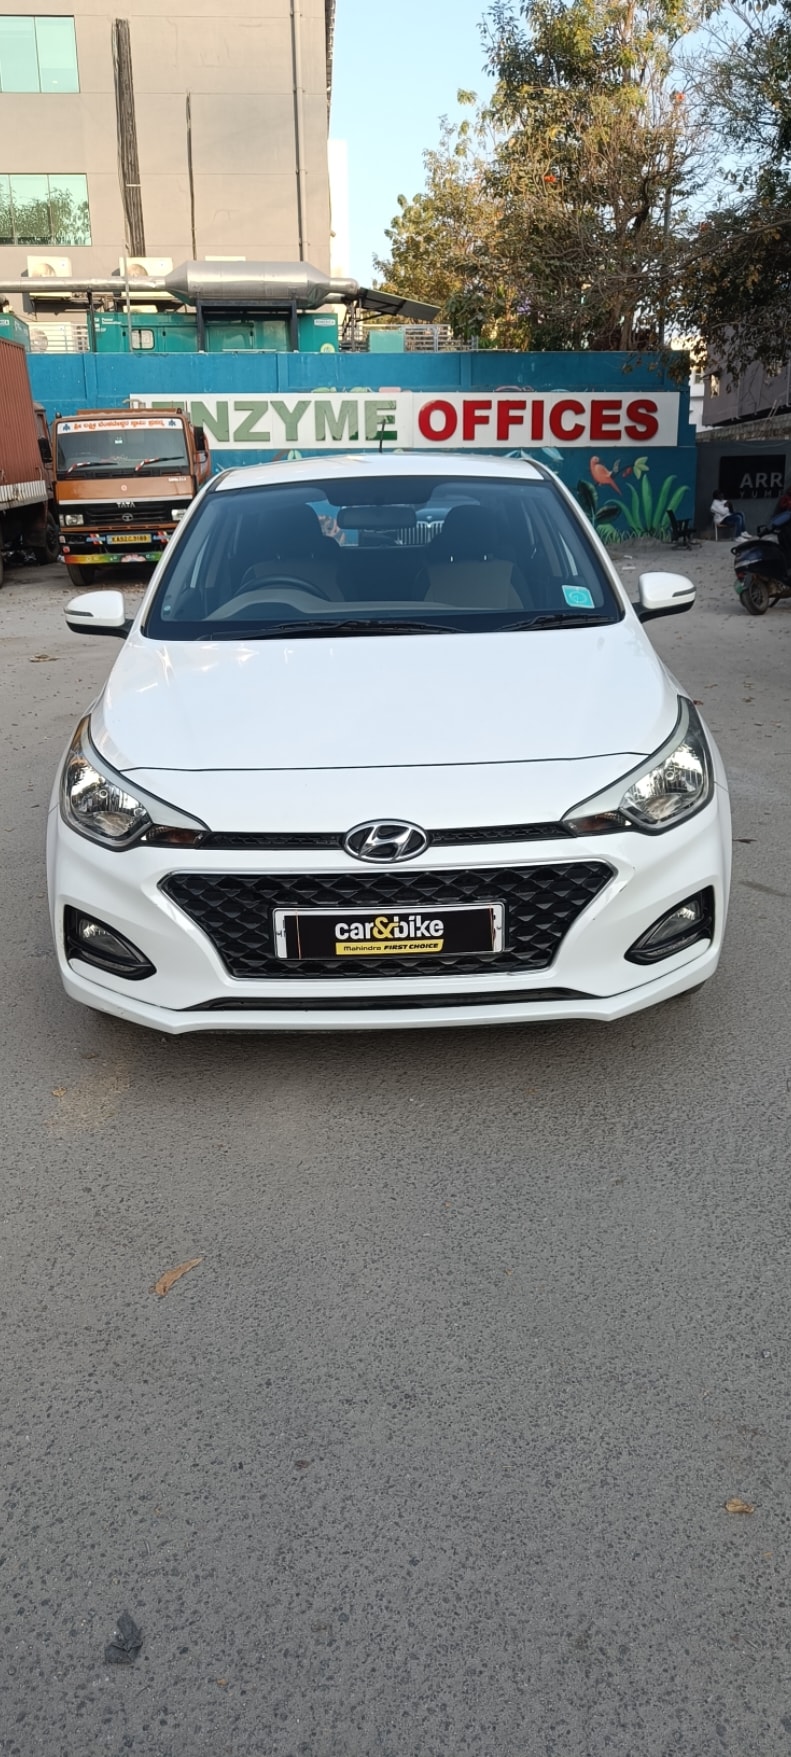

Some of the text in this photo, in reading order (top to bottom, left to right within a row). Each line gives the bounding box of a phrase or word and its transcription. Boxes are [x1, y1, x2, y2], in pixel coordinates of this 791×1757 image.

[151, 399, 659, 442] NZYME OFFICES
[739, 472, 783, 488] ARR
[116, 501, 136, 509] TATA
[335, 915, 444, 940] car&bike
